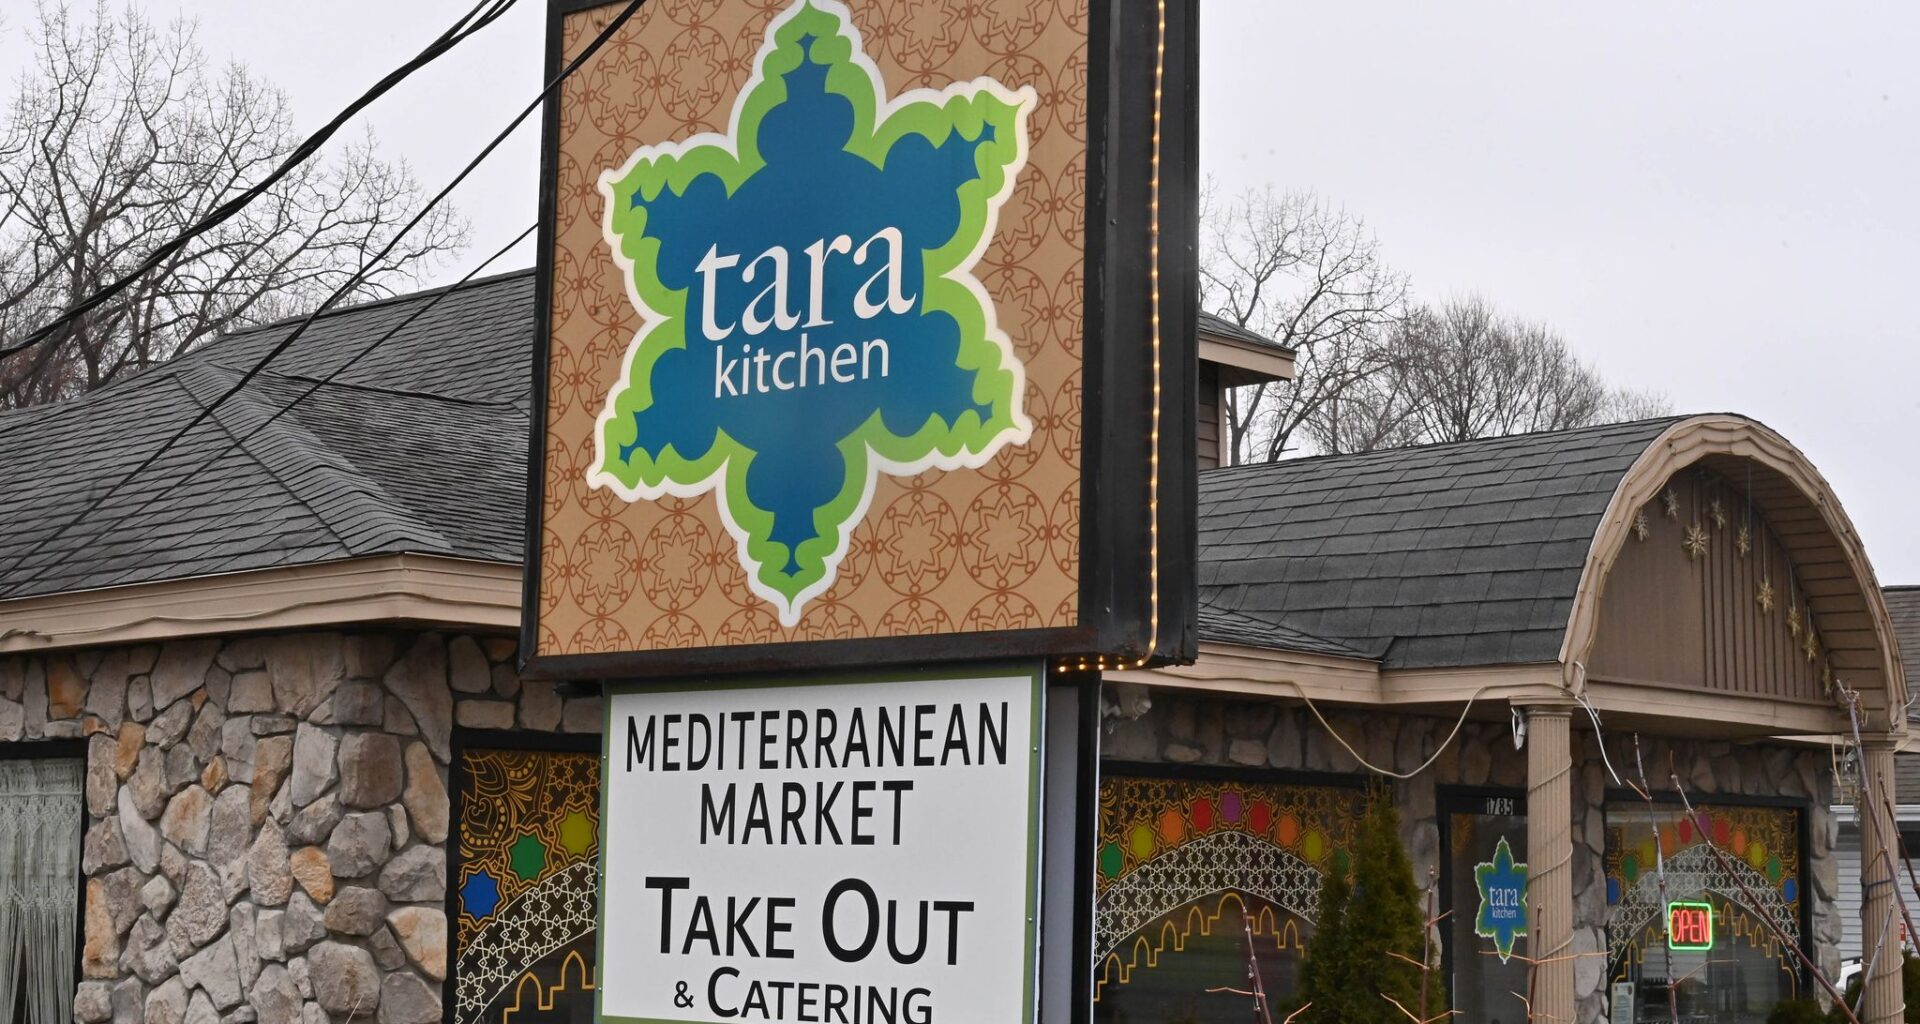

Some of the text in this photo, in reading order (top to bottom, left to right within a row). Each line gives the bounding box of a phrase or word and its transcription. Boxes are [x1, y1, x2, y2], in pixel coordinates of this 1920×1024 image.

[695, 226, 917, 341] tara
[714, 333, 889, 398] kitchen
[626, 702, 1008, 772] MEDITERRANEAN
[700, 780, 914, 845] MARKET
[1486, 797, 1513, 816] 1785
[1489, 886, 1519, 907] tara
[1492, 907, 1517, 919] kitchen
[1671, 909, 1711, 943] OPEN
[673, 980, 694, 1008] &
